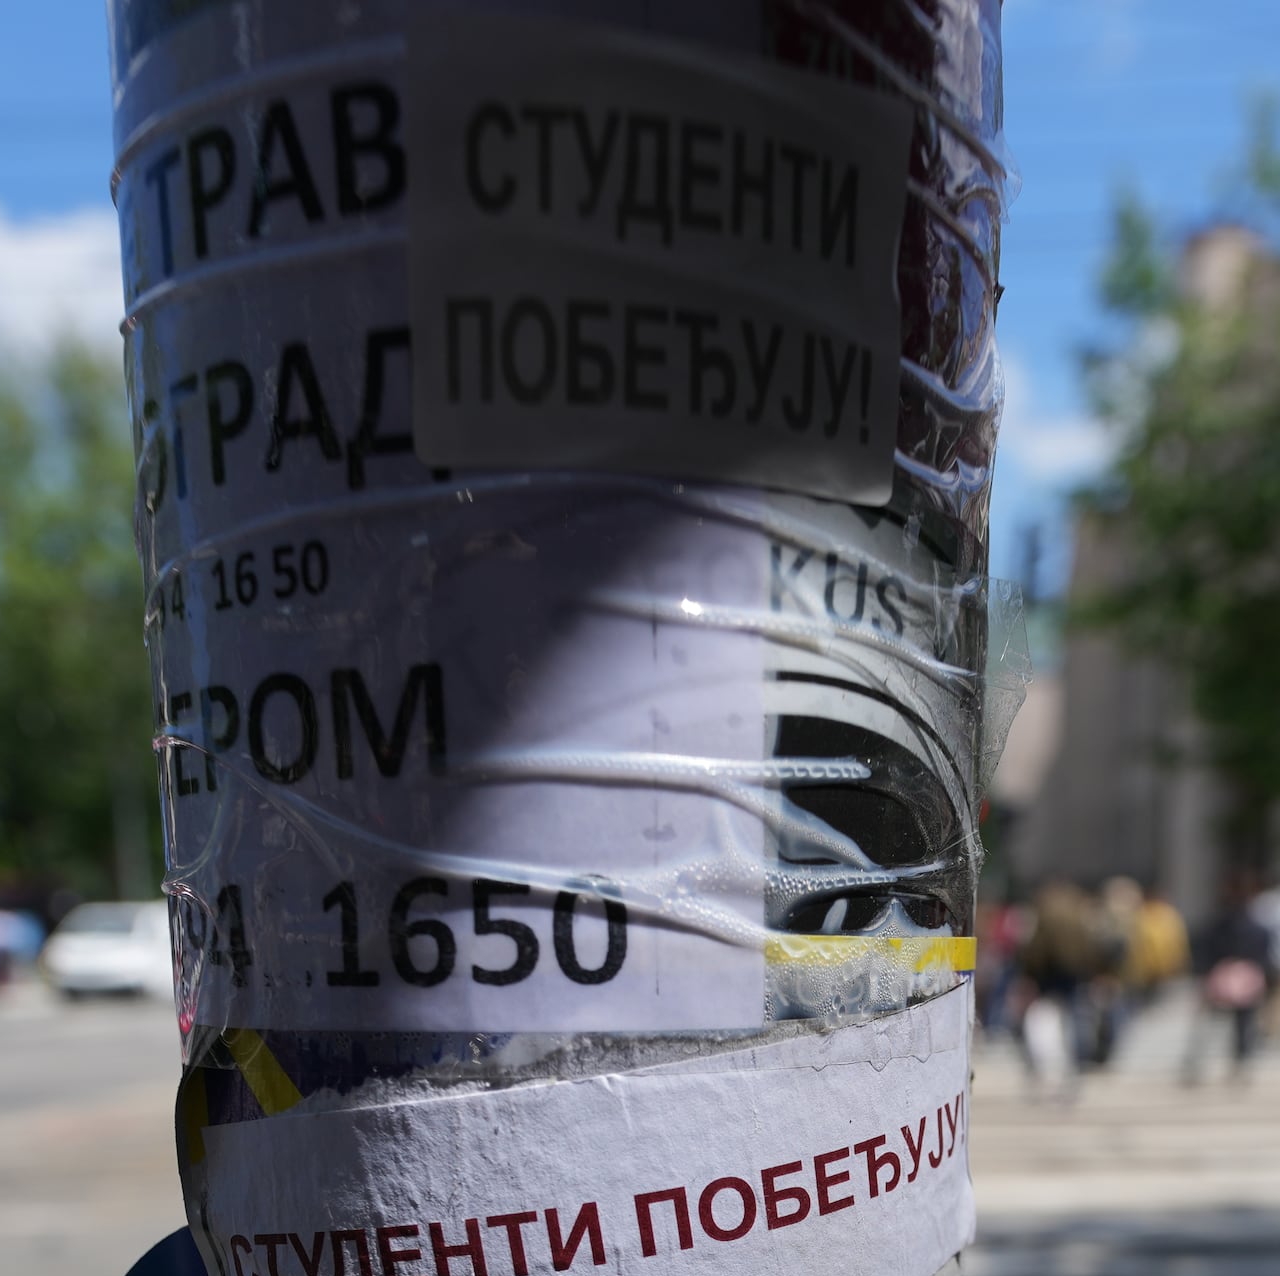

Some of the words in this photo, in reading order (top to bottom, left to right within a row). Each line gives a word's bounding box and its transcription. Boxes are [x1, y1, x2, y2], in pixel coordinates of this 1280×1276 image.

[464, 101, 861, 269] СТУДЕНТИ
[445, 292, 873, 445] ПОБЕЂУЈУ!
[323, 872, 630, 989] 1650
[634, 1090, 966, 1257] ПОБЕЂУЈУ!
